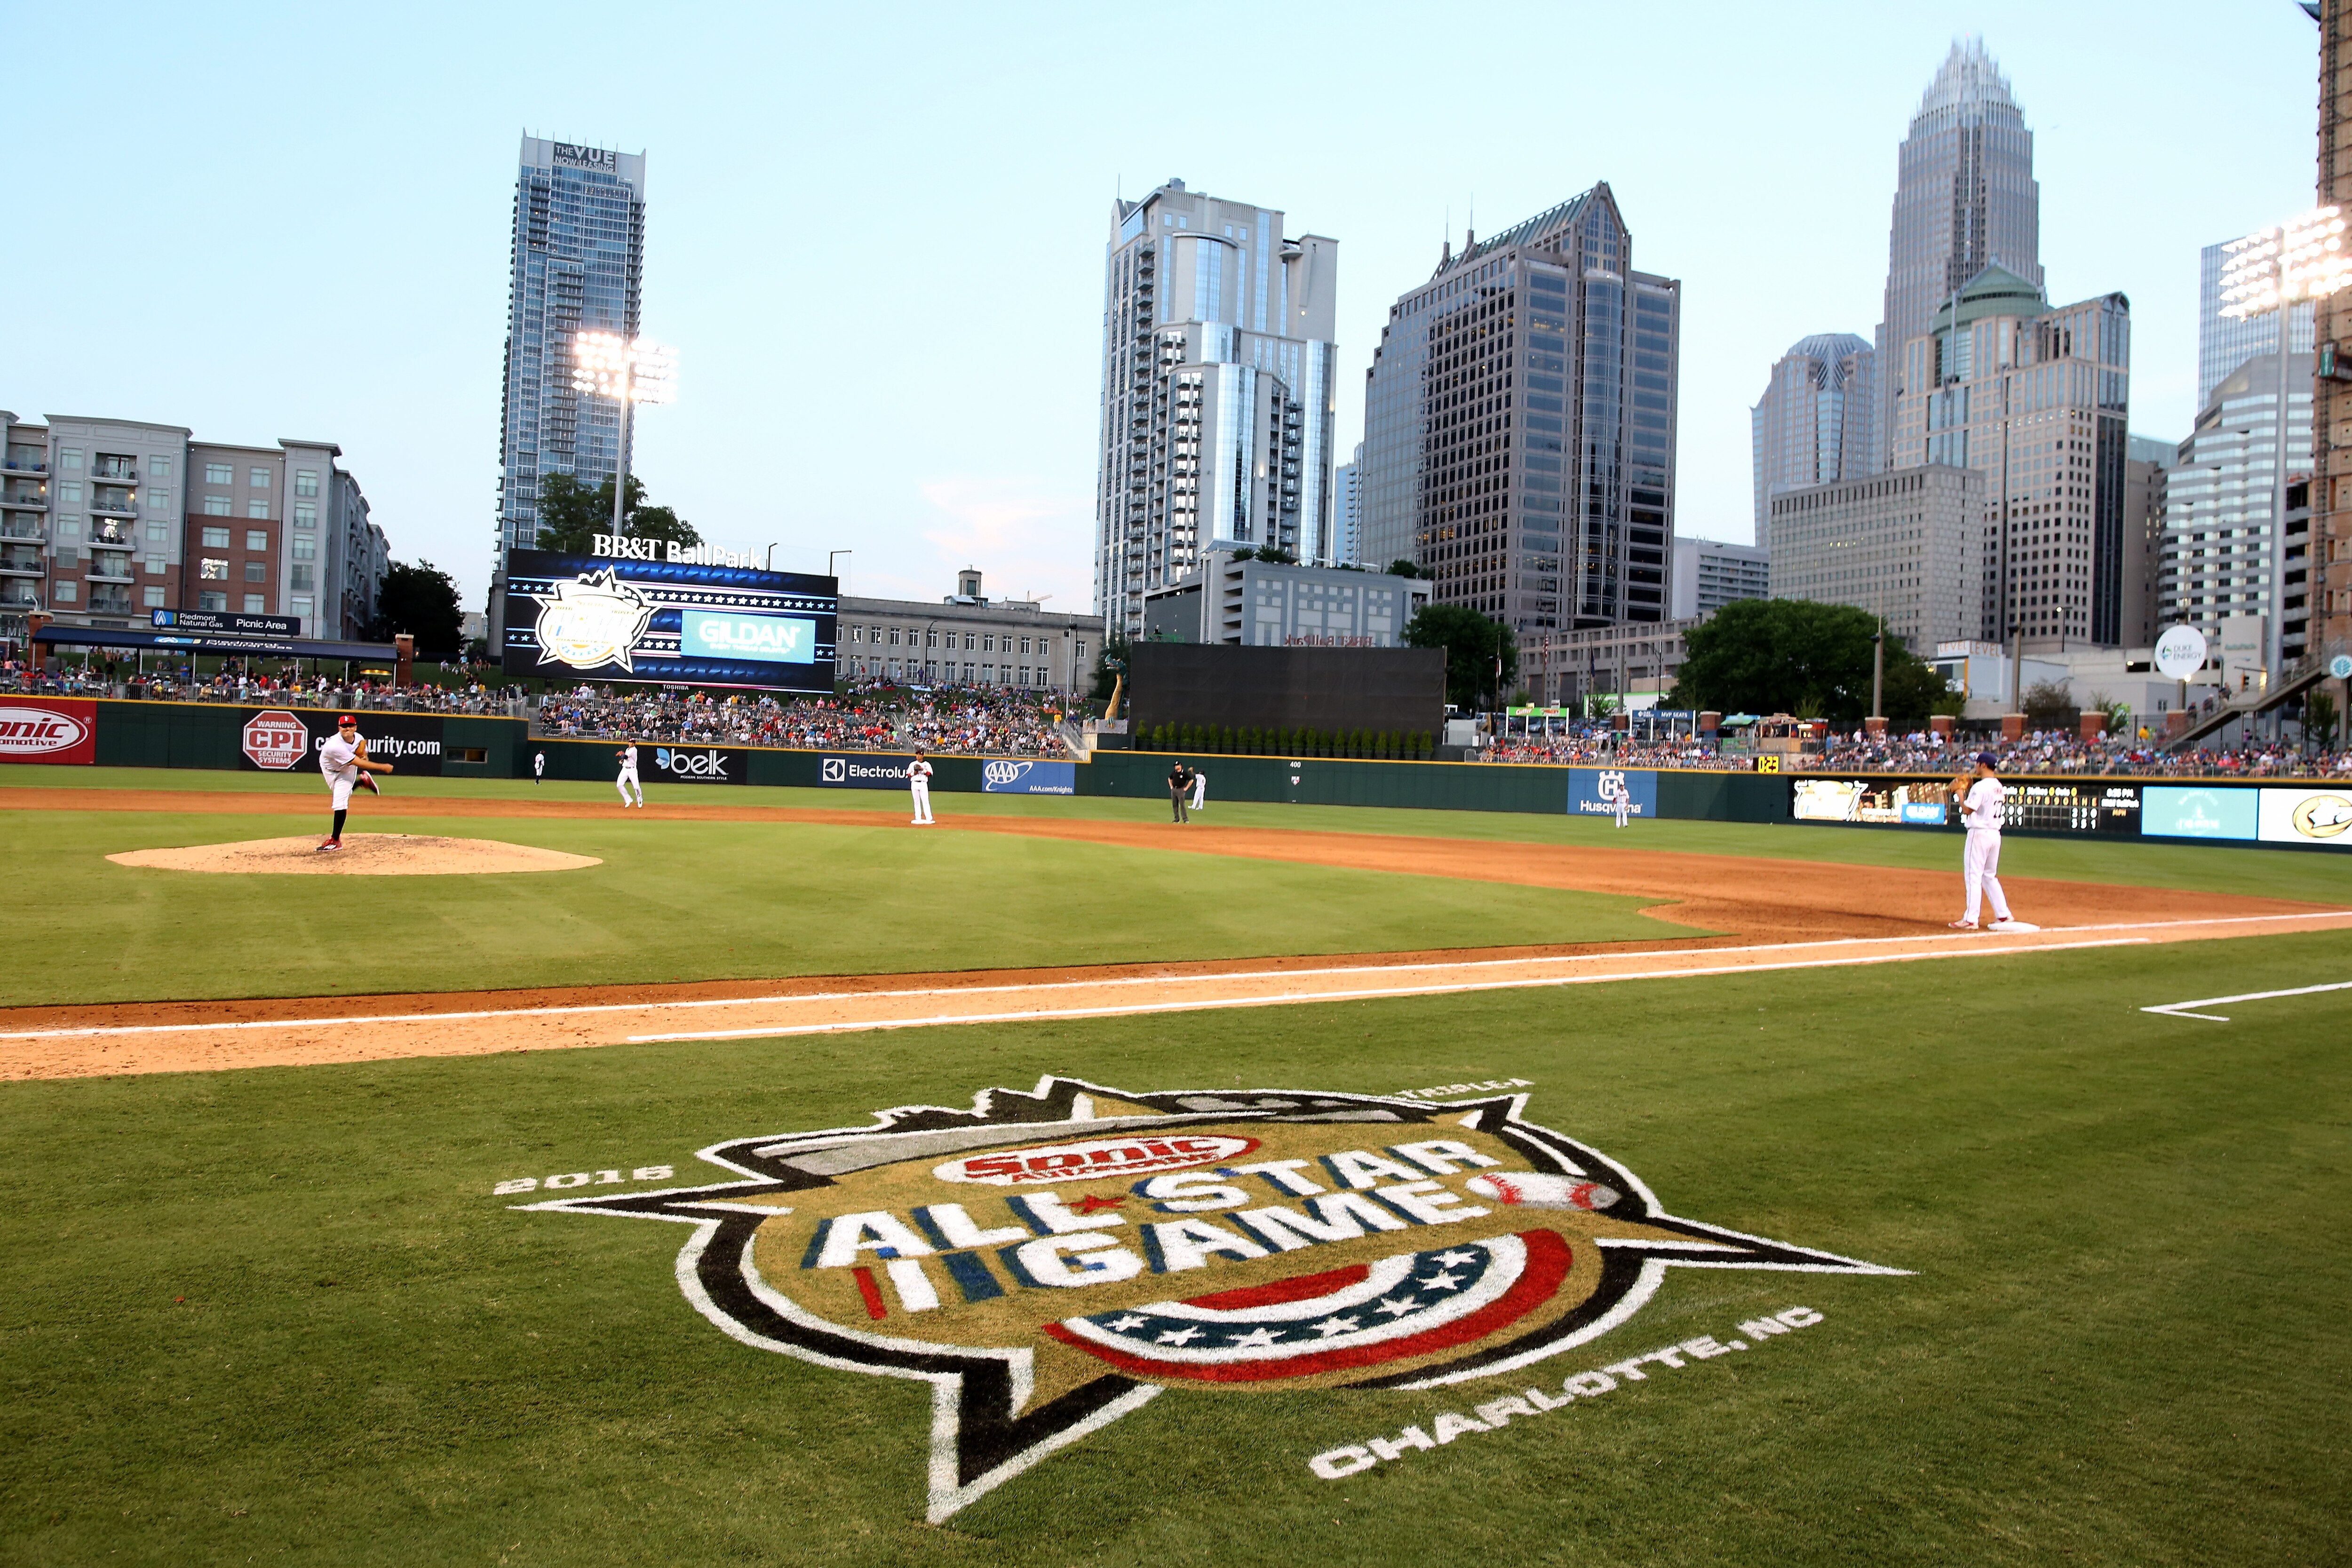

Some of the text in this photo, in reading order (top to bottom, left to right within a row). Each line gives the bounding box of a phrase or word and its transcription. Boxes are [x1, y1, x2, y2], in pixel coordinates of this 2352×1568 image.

[555, 156, 614, 172] NOW LEASING
[556, 145, 614, 165] THE VUE
[592, 533, 763, 571] BB&T BallPark
[180, 613, 287, 630] Piedmont Picnic Area
[699, 620, 796, 648] GILDAN
[1939, 640, 1967, 652] LEVEL
[1970, 640, 2000, 657] LEVEL
[257, 720, 296, 729] WARNING
[249, 730, 302, 749] CPI
[671, 748, 728, 775] belk
[1758, 756, 1779, 773] 0:23
[988, 761, 1015, 783] AAA
[1029, 785, 1073, 794] AAA.com/Knights
[2035, 796, 2042, 804] 7
[2082, 797, 2088, 806] H
[493, 1164, 675, 1195] 2016
[802, 1138, 1507, 1269] ALL STAR
[999, 1179, 1494, 1287] GAME
